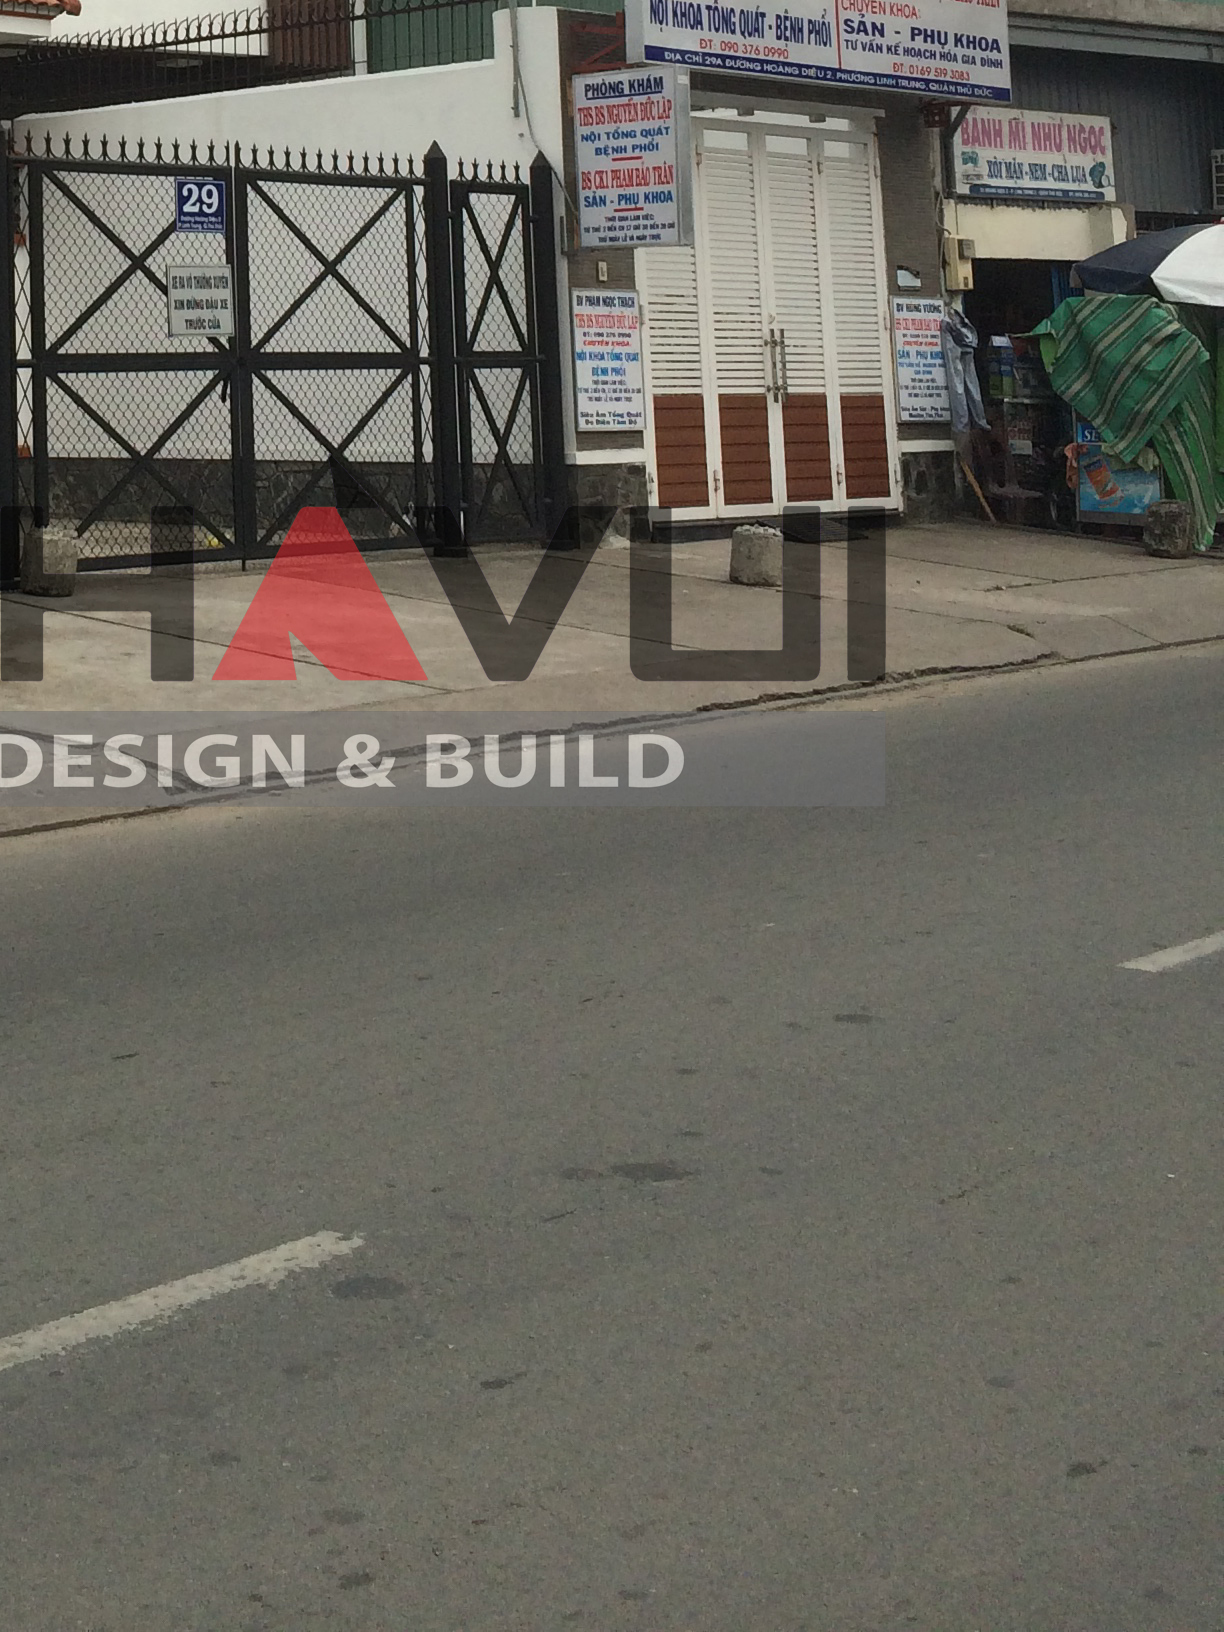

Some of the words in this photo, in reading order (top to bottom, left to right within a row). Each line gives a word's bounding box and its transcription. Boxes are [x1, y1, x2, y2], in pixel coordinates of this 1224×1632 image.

[672, 0, 704, 32] KHOA
[739, 5, 767, 39] QUÁT
[775, 9, 804, 47] BỆNH
[807, 8, 833, 48] PHỔI
[843, 13, 885, 38] SẢN
[910, 26, 948, 50] PHỤ
[953, 32, 1003, 54] KHOA
[720, 40, 739, 53] 090
[741, 43, 761, 57] 376
[763, 46, 789, 59] 0990
[876, 76, 896, 86] LINH
[909, 64, 931, 77] 0169
[933, 67, 947, 79] 519
[950, 70, 971, 82] 3083
[584, 79, 625, 98] PHÒNG
[628, 74, 664, 93] KHÁM
[182, 184, 219, 214] 29
[584, 191, 607, 208] SẢN
[617, 192, 639, 208] PHỤ
[643, 190, 674, 204] KHOA
